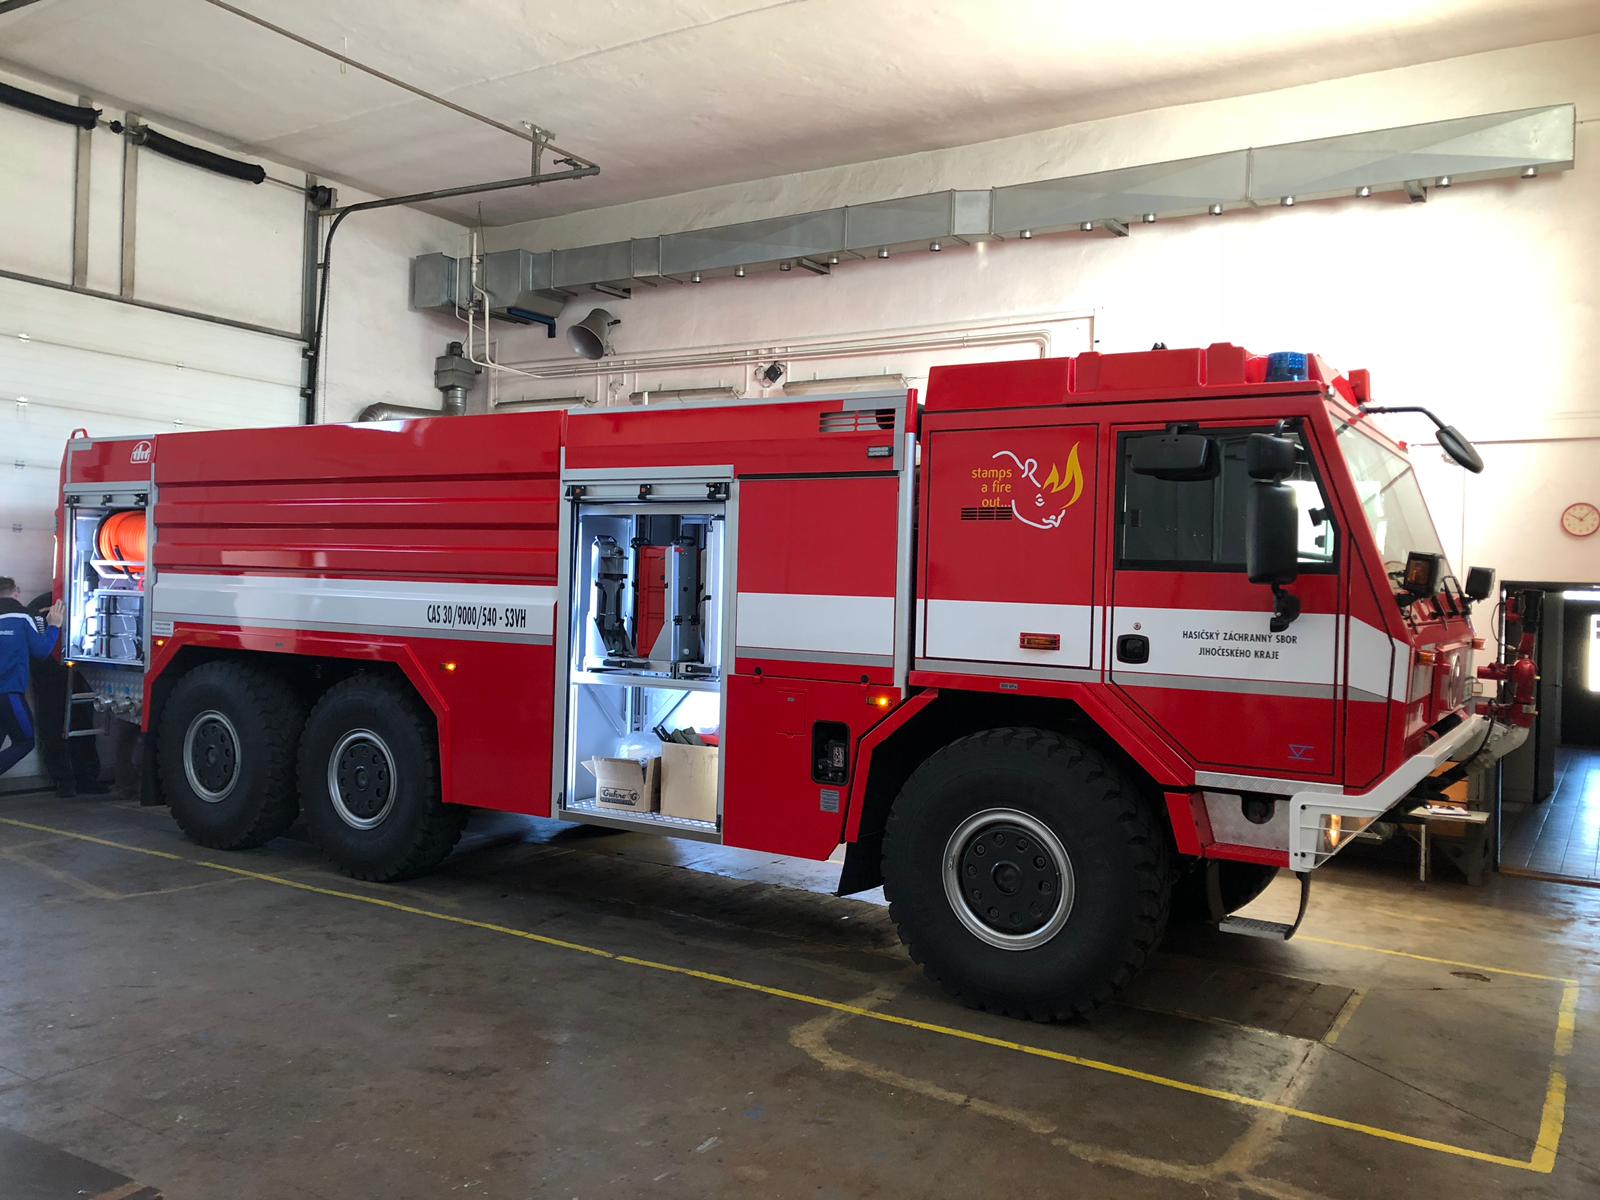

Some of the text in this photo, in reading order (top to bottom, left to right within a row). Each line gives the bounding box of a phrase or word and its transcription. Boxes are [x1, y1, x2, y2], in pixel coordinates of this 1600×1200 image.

[971, 467, 1012, 482] stamps
[981, 480, 1012, 493] a fire
[427, 604, 441, 624] CAS
[442, 604, 497, 630] 30/9000/540
[505, 607, 527, 628] S3VH
[1182, 629, 1298, 644] HASIČSKÝ ZÁCHRANNÝ SBOR
[1198, 646, 1280, 660] JIHOČESKÉHO KRAJE
